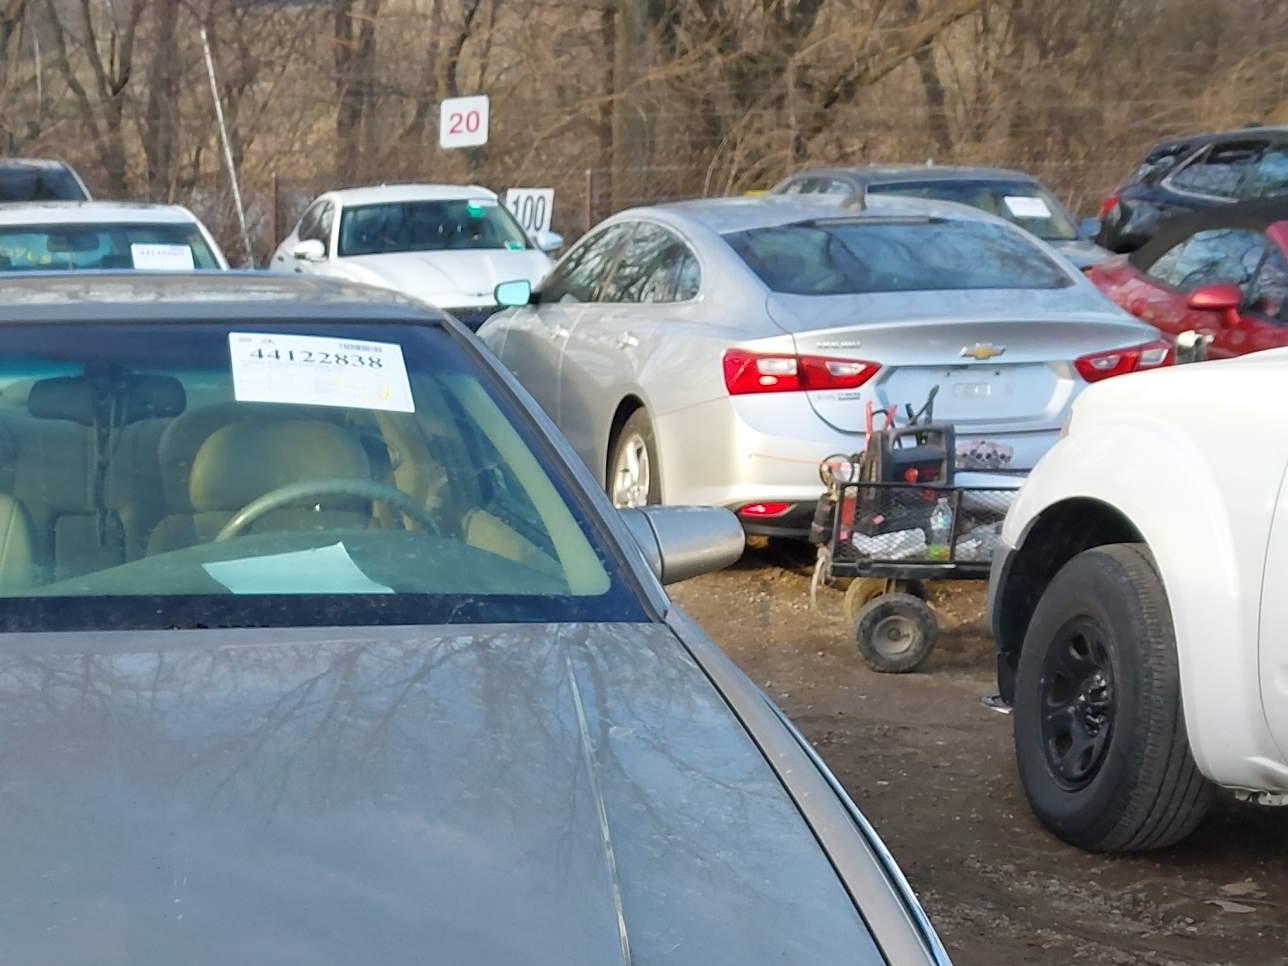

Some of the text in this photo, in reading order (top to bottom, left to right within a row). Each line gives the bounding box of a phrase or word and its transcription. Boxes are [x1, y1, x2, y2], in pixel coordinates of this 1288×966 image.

[449, 110, 480, 134] 20
[512, 194, 546, 231] 100
[249, 347, 383, 368] 44122838
